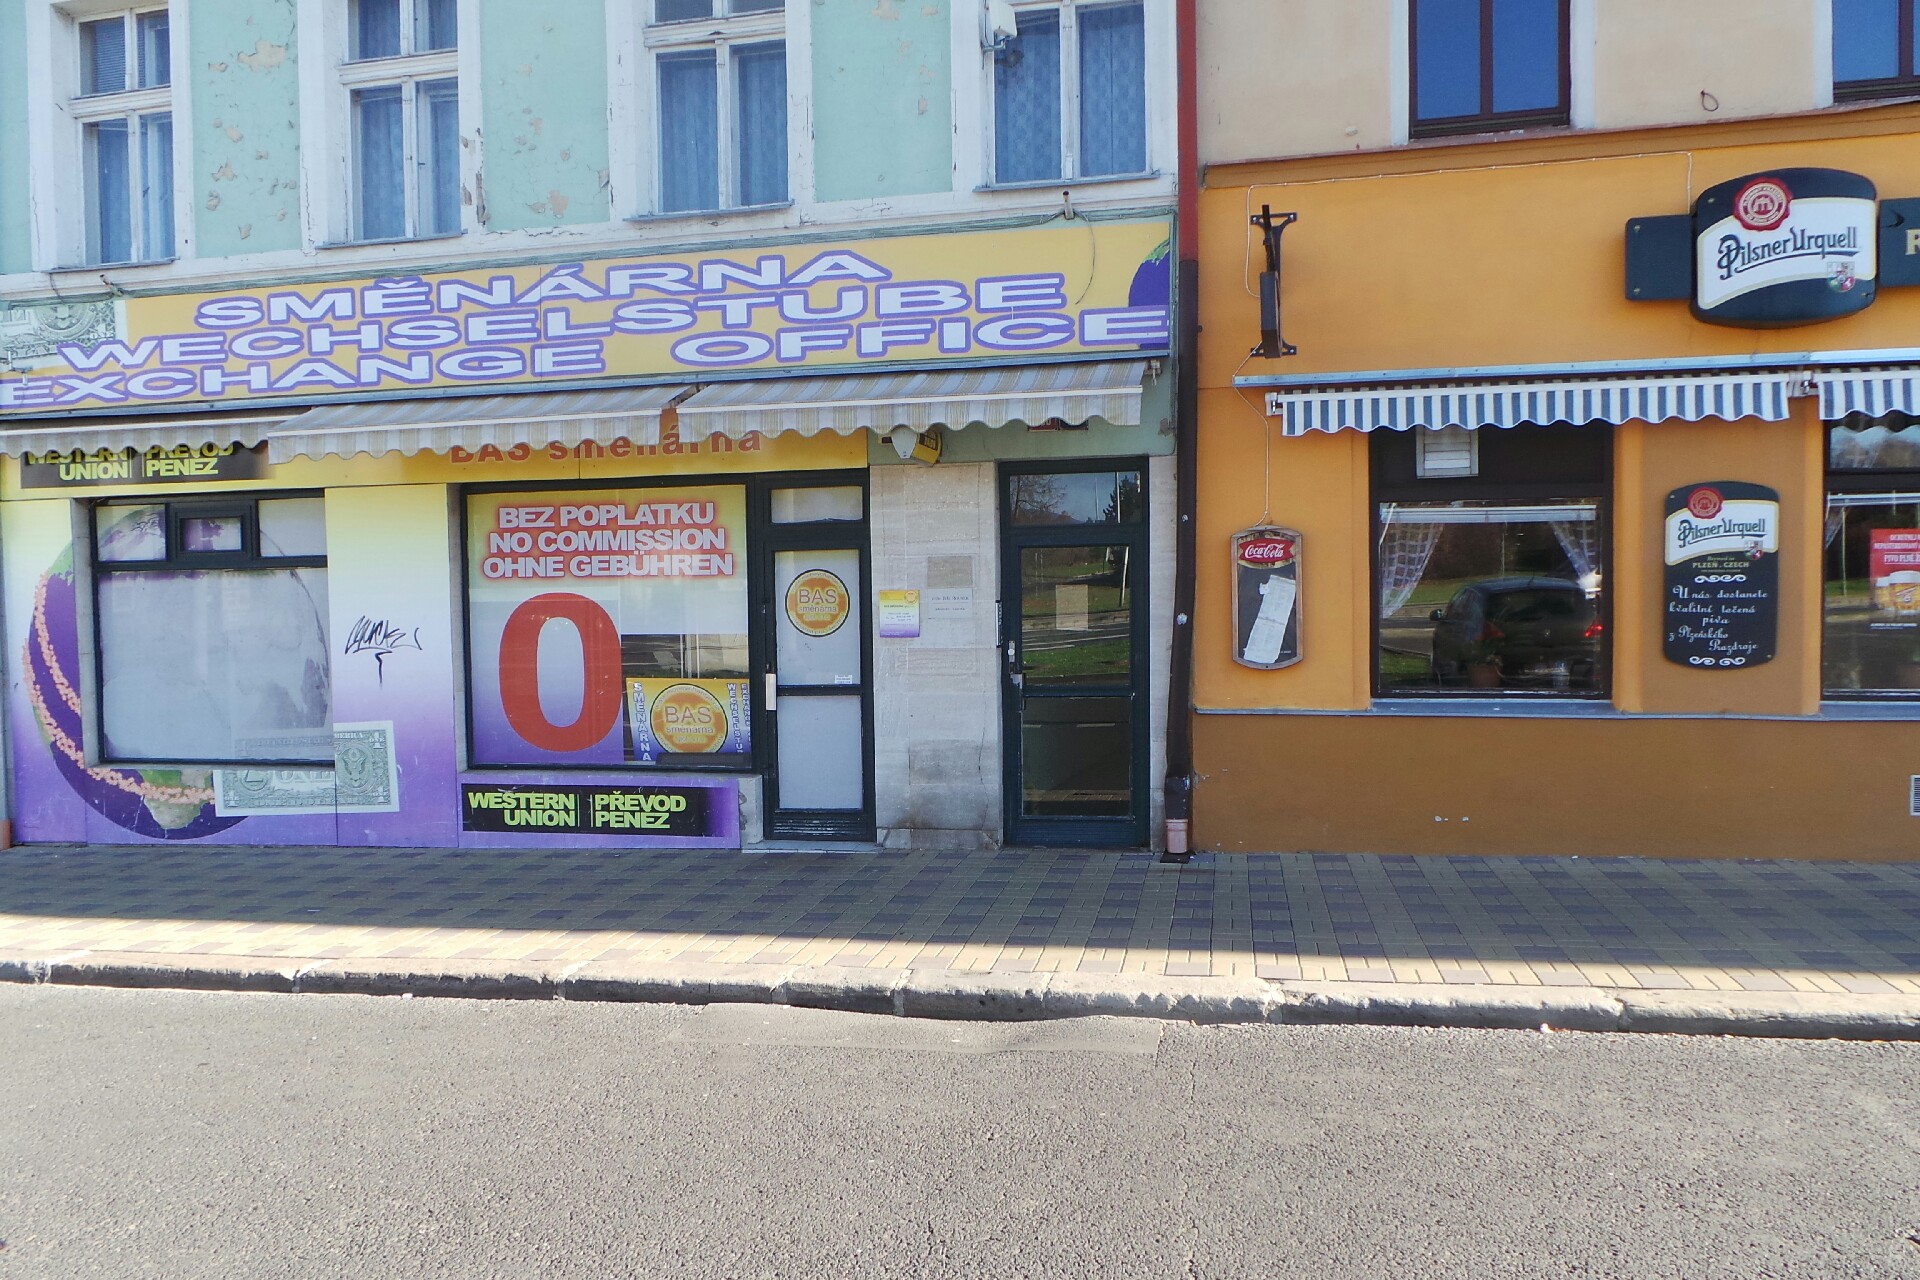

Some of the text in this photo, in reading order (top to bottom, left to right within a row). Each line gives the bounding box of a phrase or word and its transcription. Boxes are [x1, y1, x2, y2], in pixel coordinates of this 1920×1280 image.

[1717, 226, 1857, 280] Pilsner Urquell
[195, 249, 892, 330] SMĚNÁRNA
[57, 273, 1065, 372] WECHSELSTUBE
[0, 304, 1169, 409] EXCHANGE OFFICE
[59, 461, 129, 480] UNION
[499, 502, 714, 528] BEZ POPLATKU
[490, 528, 725, 553] NO COMMISSION
[1678, 518, 1766, 548] Pilsner Urquell
[483, 550, 734, 578] OHNE GEBÜHREN
[798, 588, 837, 604] BAS
[1673, 585, 1689, 599] U
[1717, 589, 1768, 599] dostanete
[1702, 614, 1730, 627] piva
[664, 706, 713, 724] BAS
[468, 792, 575, 810] WESTERN
[595, 790, 687, 811] PŘEVOD
[503, 809, 575, 827] UNION
[595, 812, 670, 829] PENEZ
